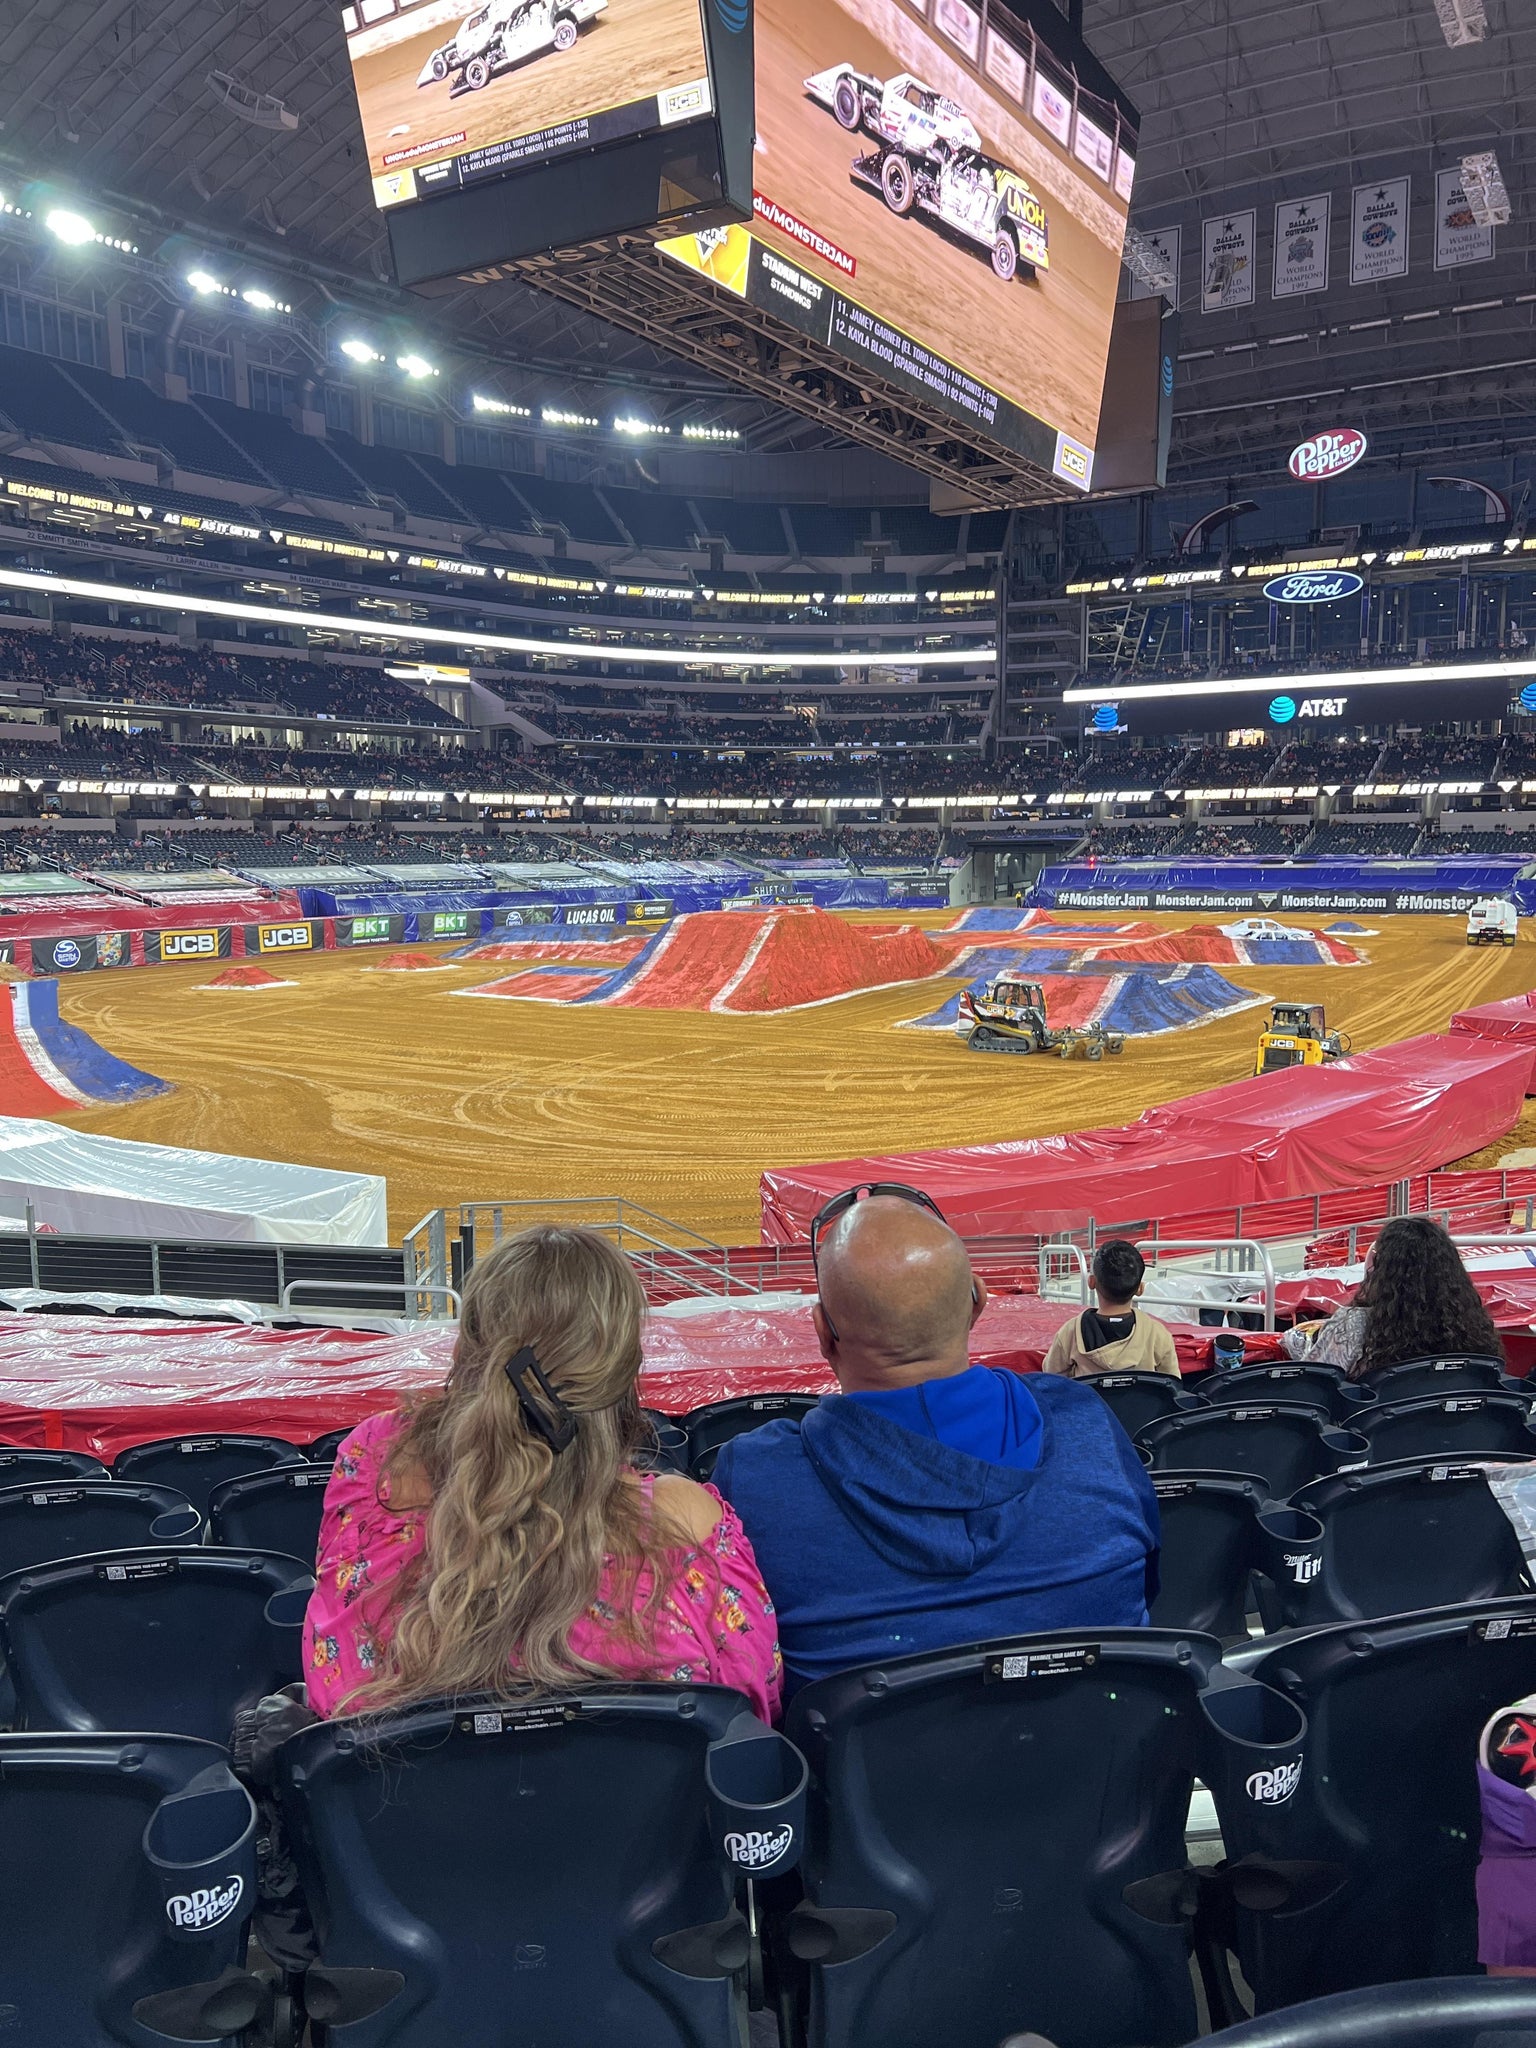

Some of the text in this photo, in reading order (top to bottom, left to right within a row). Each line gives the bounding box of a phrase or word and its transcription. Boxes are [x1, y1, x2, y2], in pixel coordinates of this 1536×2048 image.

[1007, 188, 1044, 230] UNOH
[1363, 209, 1398, 221] COWBOYS
[1367, 202, 1394, 213] DALLAS
[1289, 218, 1315, 228] DALLAS
[1286, 225, 1318, 237] COWBOYS
[1449, 233, 1480, 244] WORLD
[1213, 240, 1244, 252] COWBOYS
[1216, 234, 1242, 244] DALLAS
[457, 225, 687, 284] WINSTAR
[1365, 249, 1394, 260] WORLD
[1439, 240, 1489, 255] CHAMPIONS
[1286, 264, 1315, 274] WORLD
[1355, 256, 1403, 270] CHAMPIONS
[1277, 271, 1323, 285] CHAMPIONS
[771, 277, 811, 309] STANDINGS
[800, 275, 822, 300] WEST
[838, 300, 848, 316] 11.
[850, 309, 874, 331] JAMEY
[875, 323, 901, 348] GARNER
[902, 340, 911, 356] (EL
[913, 346, 928, 365] TORO
[929, 356, 946, 378] LOCO)
[951, 370, 961, 385] 116
[962, 376, 981, 398] POINTS
[836, 319, 846, 335] 12.
[848, 325, 869, 349] KAYLA
[871, 339, 893, 362] BLOOD
[894, 351, 923, 381] (SPARKLE
[924, 371, 946, 396] SMASH)
[951, 388, 958, 401] 92
[959, 393, 978, 412] POINTS
[1316, 435, 1343, 457] Dr
[1063, 450, 1086, 474] JCB
[1289, 440, 1360, 476] Pepper
[8, 482, 134, 517] WELCOME TO MONSTER JAM
[163, 513, 180, 525] AS
[181, 515, 200, 528] BIG
[27, 531, 35, 540] 22
[37, 533, 68, 546] EMMITT
[70, 538, 89, 549] SMITH
[286, 536, 384, 561] WELCOME TO MONSTER JAM
[176, 556, 197, 566] LARRY
[198, 560, 219, 569] ALLEN
[507, 572, 537, 585] WELCOME
[1282, 574, 1342, 599] Ford
[717, 593, 749, 602] WELCOME
[1298, 697, 1347, 717] AT&T
[57, 781, 78, 793] AS
[80, 782, 103, 793] BIG
[104, 783, 124, 794] AS
[124, 784, 138, 794] IT
[209, 786, 253, 798] WELCOME
[1353, 785, 1374, 795] AS
[1400, 783, 1420, 794] AS
[1421, 783, 1438, 794] IT
[755, 886, 778, 894] SHIFT
[1058, 893, 1148, 907] #MonsterJam
[1156, 894, 1252, 907] MonsterJam.com
[1282, 895, 1386, 908] MonsterJam.com
[1396, 895, 1498, 910] #Monster
[434, 915, 467, 930] BKT
[567, 908, 615, 924] LUCAS OIL
[353, 919, 389, 936] BKT
[166, 934, 215, 954] JCB
[264, 928, 308, 947] JCB
[987, 1006, 1004, 1015] JCB
[1270, 1040, 1294, 1048] JCB
[515, 1722, 563, 1731] Blockchain.com
[1273, 1763, 1295, 1784] Dr
[746, 1831, 773, 1849] Dr
[724, 1831, 788, 1865] Pepper
[166, 1883, 238, 1926] Pepper
[191, 1886, 221, 1909] Dr
